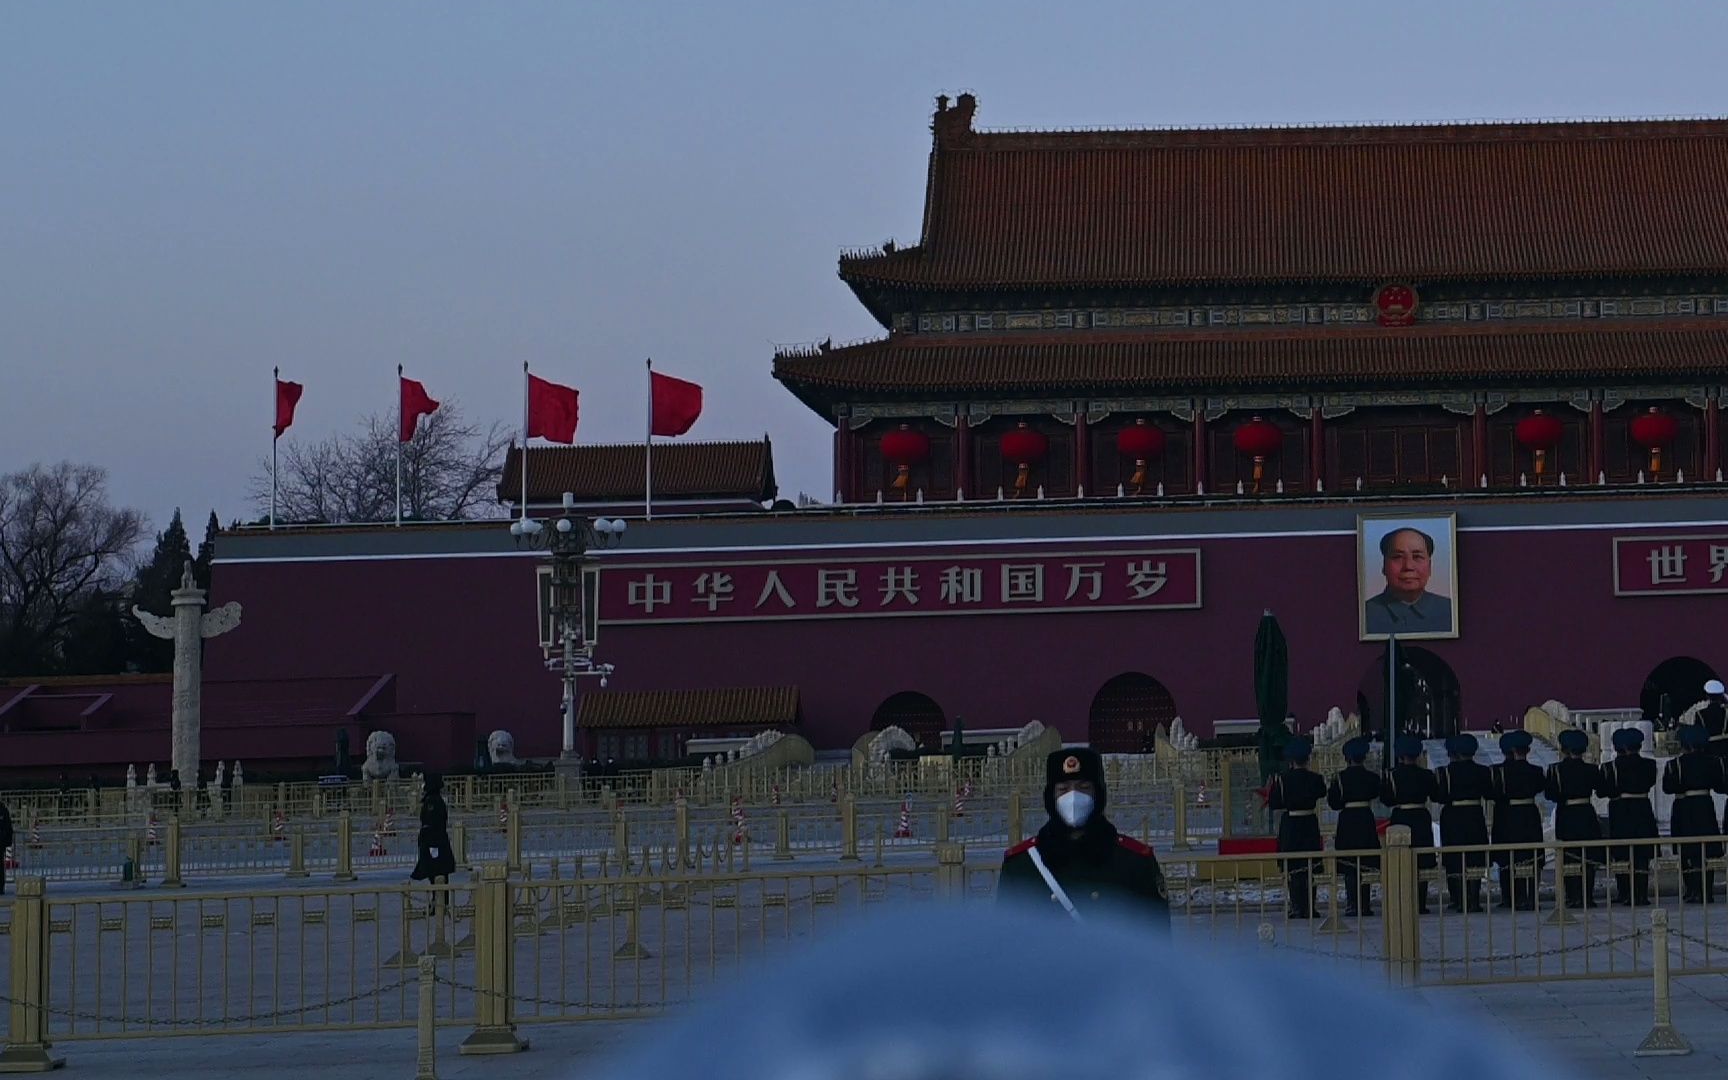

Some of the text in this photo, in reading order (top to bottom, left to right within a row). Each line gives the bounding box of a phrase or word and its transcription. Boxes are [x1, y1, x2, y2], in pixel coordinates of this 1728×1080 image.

[627, 560, 1168, 613] 中华人民共和国万岁
